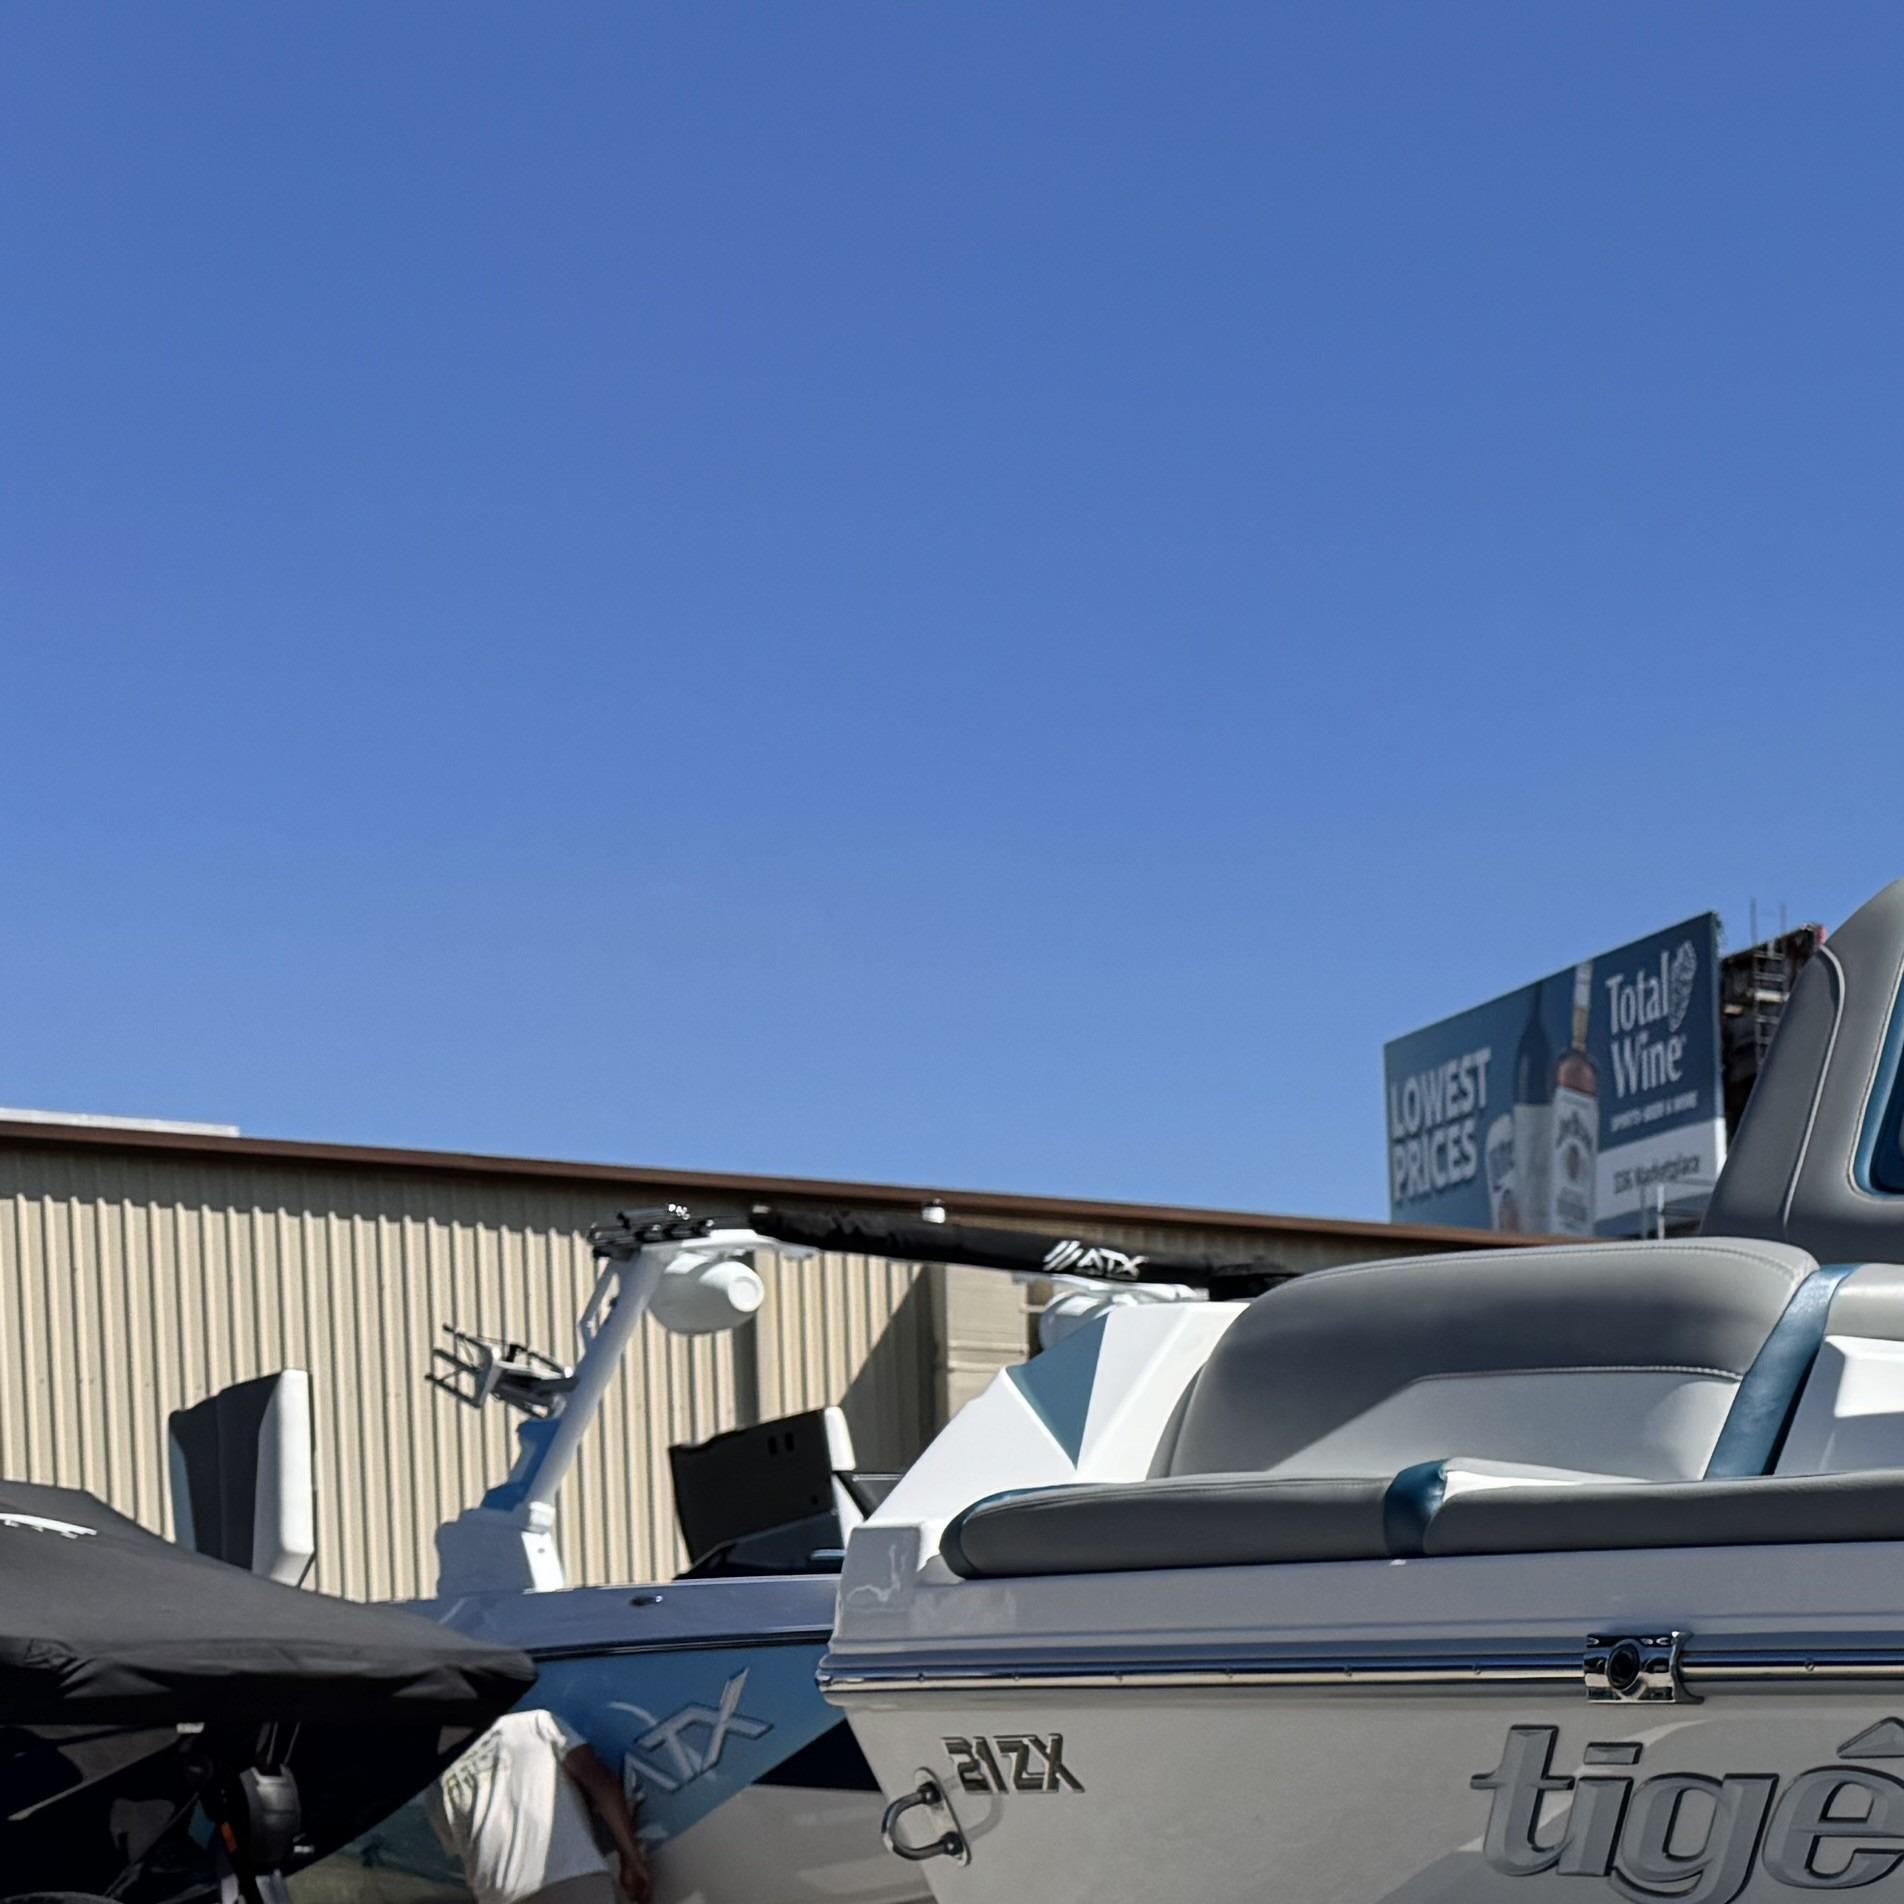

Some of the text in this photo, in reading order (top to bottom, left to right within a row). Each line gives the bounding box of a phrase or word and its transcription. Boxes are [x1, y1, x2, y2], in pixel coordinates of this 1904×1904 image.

[1605, 951, 1670, 1035] Total
[1391, 1047, 1492, 1139] LOWEST
[1610, 1029, 1684, 1099] Wine
[1393, 1117, 1478, 1201] PRICES
[942, 1733, 1085, 1794] 21ZX
